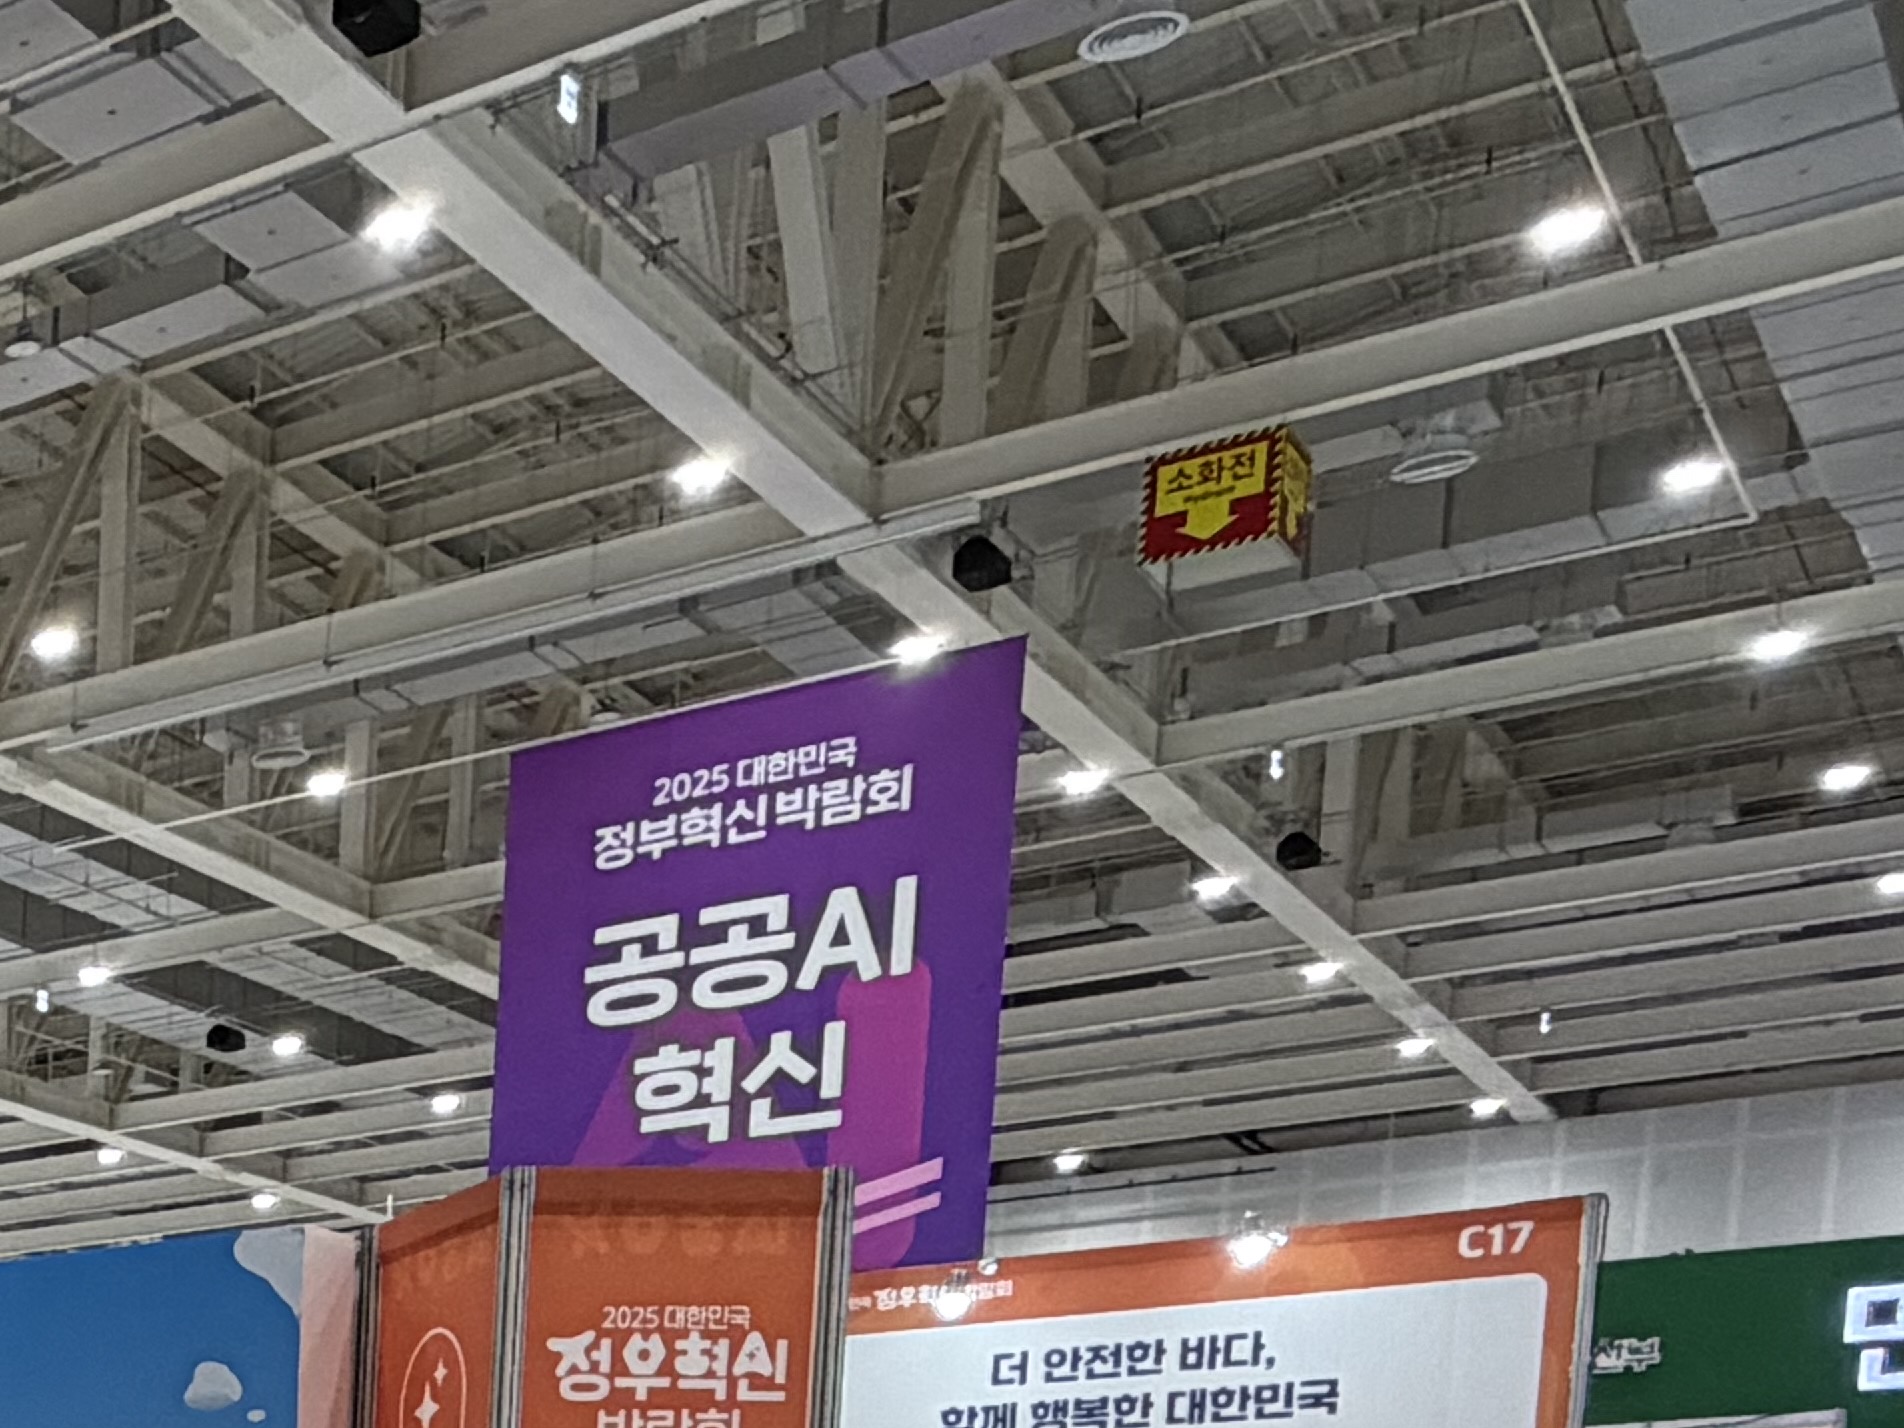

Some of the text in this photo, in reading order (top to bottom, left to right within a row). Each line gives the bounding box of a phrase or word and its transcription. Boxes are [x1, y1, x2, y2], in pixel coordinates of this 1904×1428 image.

[1165, 449, 1255, 495] 소화전
[652, 736, 857, 807] 2025 대한민국
[594, 763, 914, 870] 정부혁신 박람회
[583, 874, 919, 1027] 공공AI
[633, 1019, 847, 1142] 혁신
[1457, 1221, 1535, 1260] C17
[601, 1305, 751, 1330] 2025 대한민국
[991, 1330, 1276, 1386] 더 안전한 바다,
[1165, 1378, 1339, 1425] 대한민국
